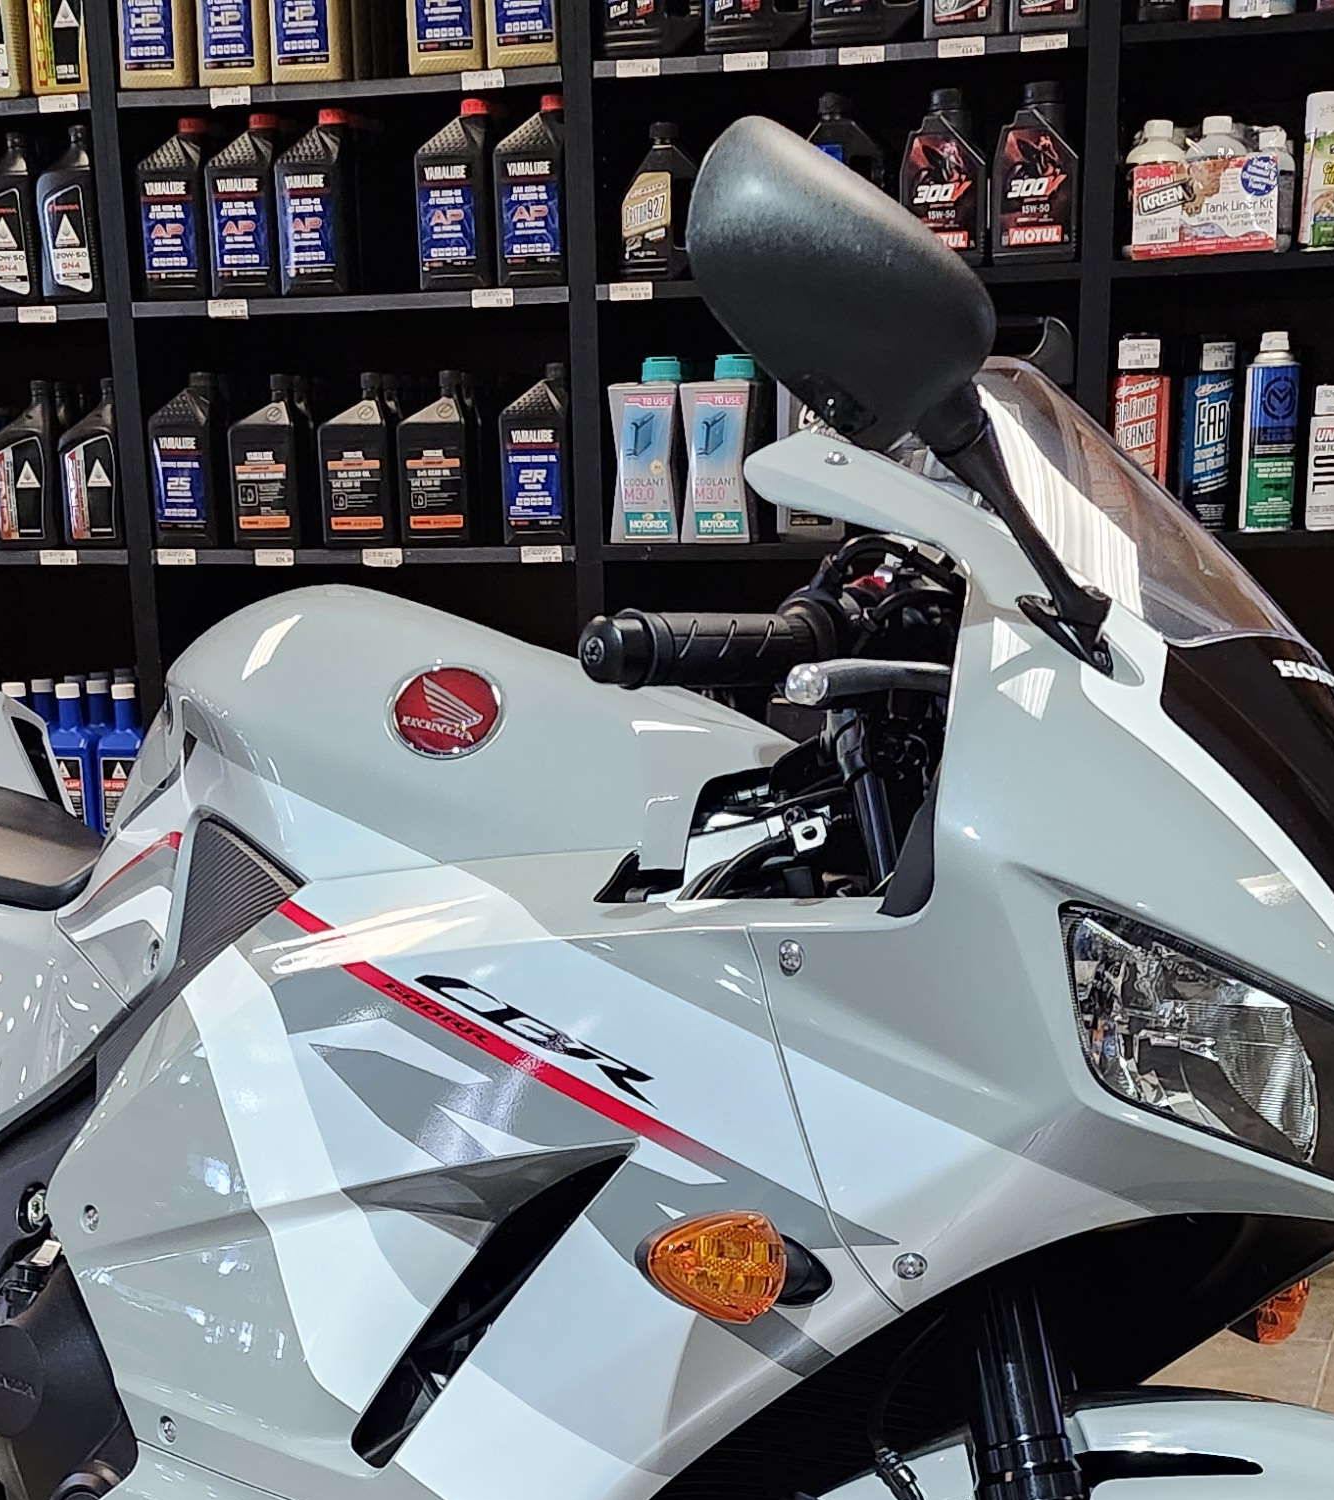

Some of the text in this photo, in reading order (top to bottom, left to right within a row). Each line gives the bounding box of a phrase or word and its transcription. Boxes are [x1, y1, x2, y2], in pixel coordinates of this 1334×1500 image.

[424, 164, 467, 181] YAMALUBE
[507, 161, 551, 177] YAMALUBE
[144, 180, 186, 196] YAMALUBE
[216, 177, 258, 193] YAMALUBE
[284, 174, 325, 189] YAMALUBE
[1007, 174, 1067, 199] 300V
[1135, 174, 1175, 189] Original
[913, 180, 972, 205] 300V
[1142, 185, 1187, 212] KREEM
[512, 205, 549, 222] AP
[927, 208, 956, 221] 15W-50
[1021, 202, 1051, 215] 15W-50
[1205, 202, 1228, 214] Tank
[290, 216, 322, 232] AP
[430, 208, 464, 226] AP
[150, 223, 185, 238] AP
[222, 220, 256, 236] AP
[1009, 226, 1061, 245] MOTUL
[55, 251, 87, 260] 20W-50
[61, 260, 81, 270] GN4
[642, 396, 669, 407] TO USE
[714, 396, 741, 406] TO USE
[158, 436, 197, 451] YAMALUBE
[510, 428, 555, 445] YAMALUBE
[623, 477, 665, 488] COOLANT
[694, 476, 737, 487] COOLANT
[624, 487, 655, 501] M3.0
[695, 487, 726, 501] M3.0
[629, 518, 668, 530] MOTOREX
[699, 518, 739, 530] MOTOREX
[400, 715, 475, 743] HONDA
[413, 974, 659, 1111] CBR
